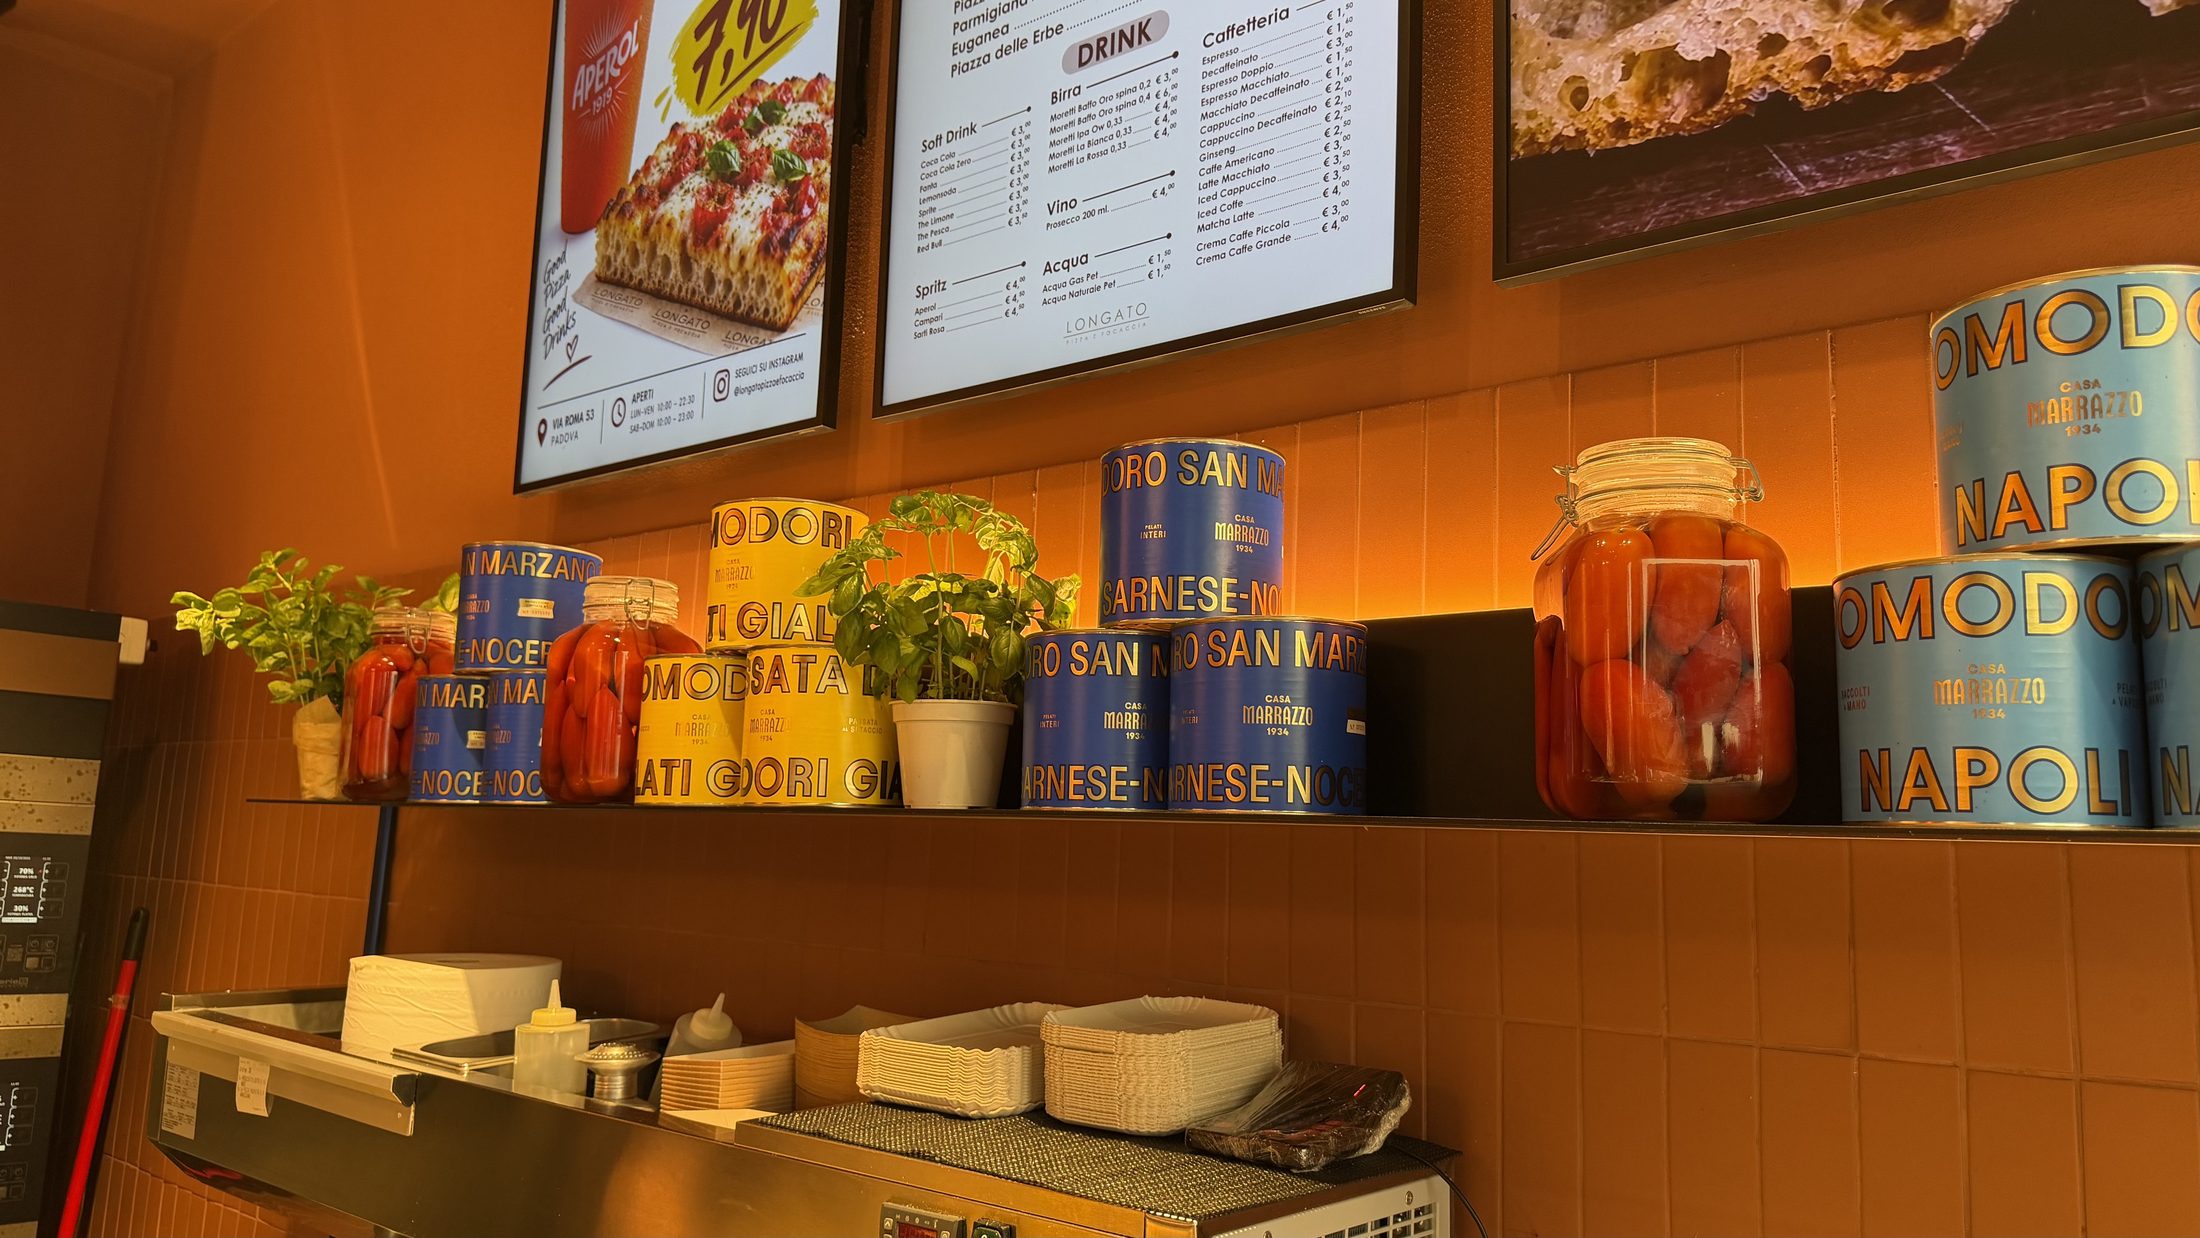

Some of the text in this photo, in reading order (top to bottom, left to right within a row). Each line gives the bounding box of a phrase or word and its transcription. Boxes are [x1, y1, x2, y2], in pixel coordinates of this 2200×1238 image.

[953, 0, 1028, 36] Parmigiana
[1202, 7, 1290, 48] Caffetteria
[950, 23, 1064, 79] Piazza delle Erbe
[951, 23, 1010, 57] Euganea
[1077, 18, 1153, 69] DRINK
[572, 19, 639, 111] APEROL
[1201, 53, 1259, 80] Decaffeinato
[1202, 46, 1239, 66] Espresso
[1200, 69, 1290, 108] Espresso Macchiato
[1201, 74, 1238, 94] Espresso
[1240, 61, 1274, 81] Doppio
[592, 86, 613, 115] 1919
[1049, 79, 1152, 123] Moretti Baffo Oro spina 0,2
[1050, 84, 1082, 105] Birra
[1200, 77, 1310, 122] Macchiato Decaffeinato
[1049, 92, 1151, 136] Moretti Baffo Oro spina 0,4
[1199, 110, 1255, 136] Cappuccino
[1199, 104, 1318, 149] Cappuccino Decaffeinato
[921, 121, 977, 154] Soft Drink
[1048, 131, 1075, 149] Moretti
[1106, 116, 1123, 129] 0,33
[1048, 125, 1133, 162] Moretti Bianca 0,33
[920, 151, 956, 169] Coca Cola
[1047, 140, 1127, 175] Moretti Rossa 0,33
[1198, 147, 1275, 177] Caffe Americano
[1199, 144, 1236, 163] Ginseng
[920, 158, 972, 181] Coca Cola Zero
[1198, 162, 1270, 191] Latte Macchiato
[919, 181, 938, 194] Fanta
[919, 187, 957, 205] Lemonsoda
[1197, 175, 1277, 205] Iced Cappuccino
[930, 212, 955, 226] Limone
[1046, 198, 1078, 216] Vino
[1046, 214, 1080, 231] Prosecco
[1082, 208, 1096, 220] 200
[1197, 199, 1244, 220] Iced Coffe
[1196, 210, 1255, 234] Matcha Latte
[1196, 236, 1227, 252] Crema
[1228, 229, 1253, 243] Caffe
[1255, 219, 1290, 236] Piccola
[543, 239, 569, 284] Good
[1195, 250, 1227, 266] Crema
[1228, 243, 1253, 257] Caffe
[1255, 233, 1292, 250] Grande
[1042, 253, 1089, 276] Acqua
[544, 269, 571, 307] Pizza
[915, 279, 947, 300] Spritz
[1041, 279, 1116, 307] Acqua Naturale Pet
[1042, 270, 1099, 294] Acqua Gas Pet
[543, 285, 568, 334] Good
[594, 288, 643, 307] LONGATO
[914, 302, 937, 316] Aperol
[655, 308, 711, 331] LONGATO
[914, 312, 943, 328] Campari
[928, 325, 945, 336] Rosa
[1066, 302, 1147, 334] LONGATO
[543, 309, 576, 360] Drinks
[1934, 283, 2200, 391] OMOD
[735, 352, 804, 379] SEGUICI SU INSTAGRAM
[631, 389, 654, 405] APERTI
[2059, 379, 2102, 393] CASA
[552, 408, 595, 431] VIA ROMA 53
[2027, 390, 2143, 428] MARRAZZO
[551, 430, 578, 446] PADOVA
[2065, 424, 2102, 437] 1934
[1176, 449, 1248, 489] SAN
[1234, 514, 1255, 523] CASA
[1140, 530, 1167, 539] INTERI
[1215, 522, 1269, 546] MARRAZZO
[1235, 544, 1254, 554] 1934
[736, 601, 835, 643] GIAL
[1837, 570, 2137, 650] OMODO
[1069, 640, 1139, 677] SAN
[1206, 628, 1281, 668] SAN
[746, 654, 849, 695] SATA
[1968, 663, 2007, 675] CASA
[431, 683, 487, 709] MAR
[1265, 694, 1291, 704] CASA
[1934, 677, 2046, 706] MARRAZZO
[1125, 702, 1147, 710] CASA
[1242, 705, 1313, 726] MARRAZZO
[1972, 708, 2006, 720] 1934
[1266, 727, 1289, 736] 1934
[1858, 745, 2132, 817] NAPOLI
[19, 867, 34, 875] 70%
